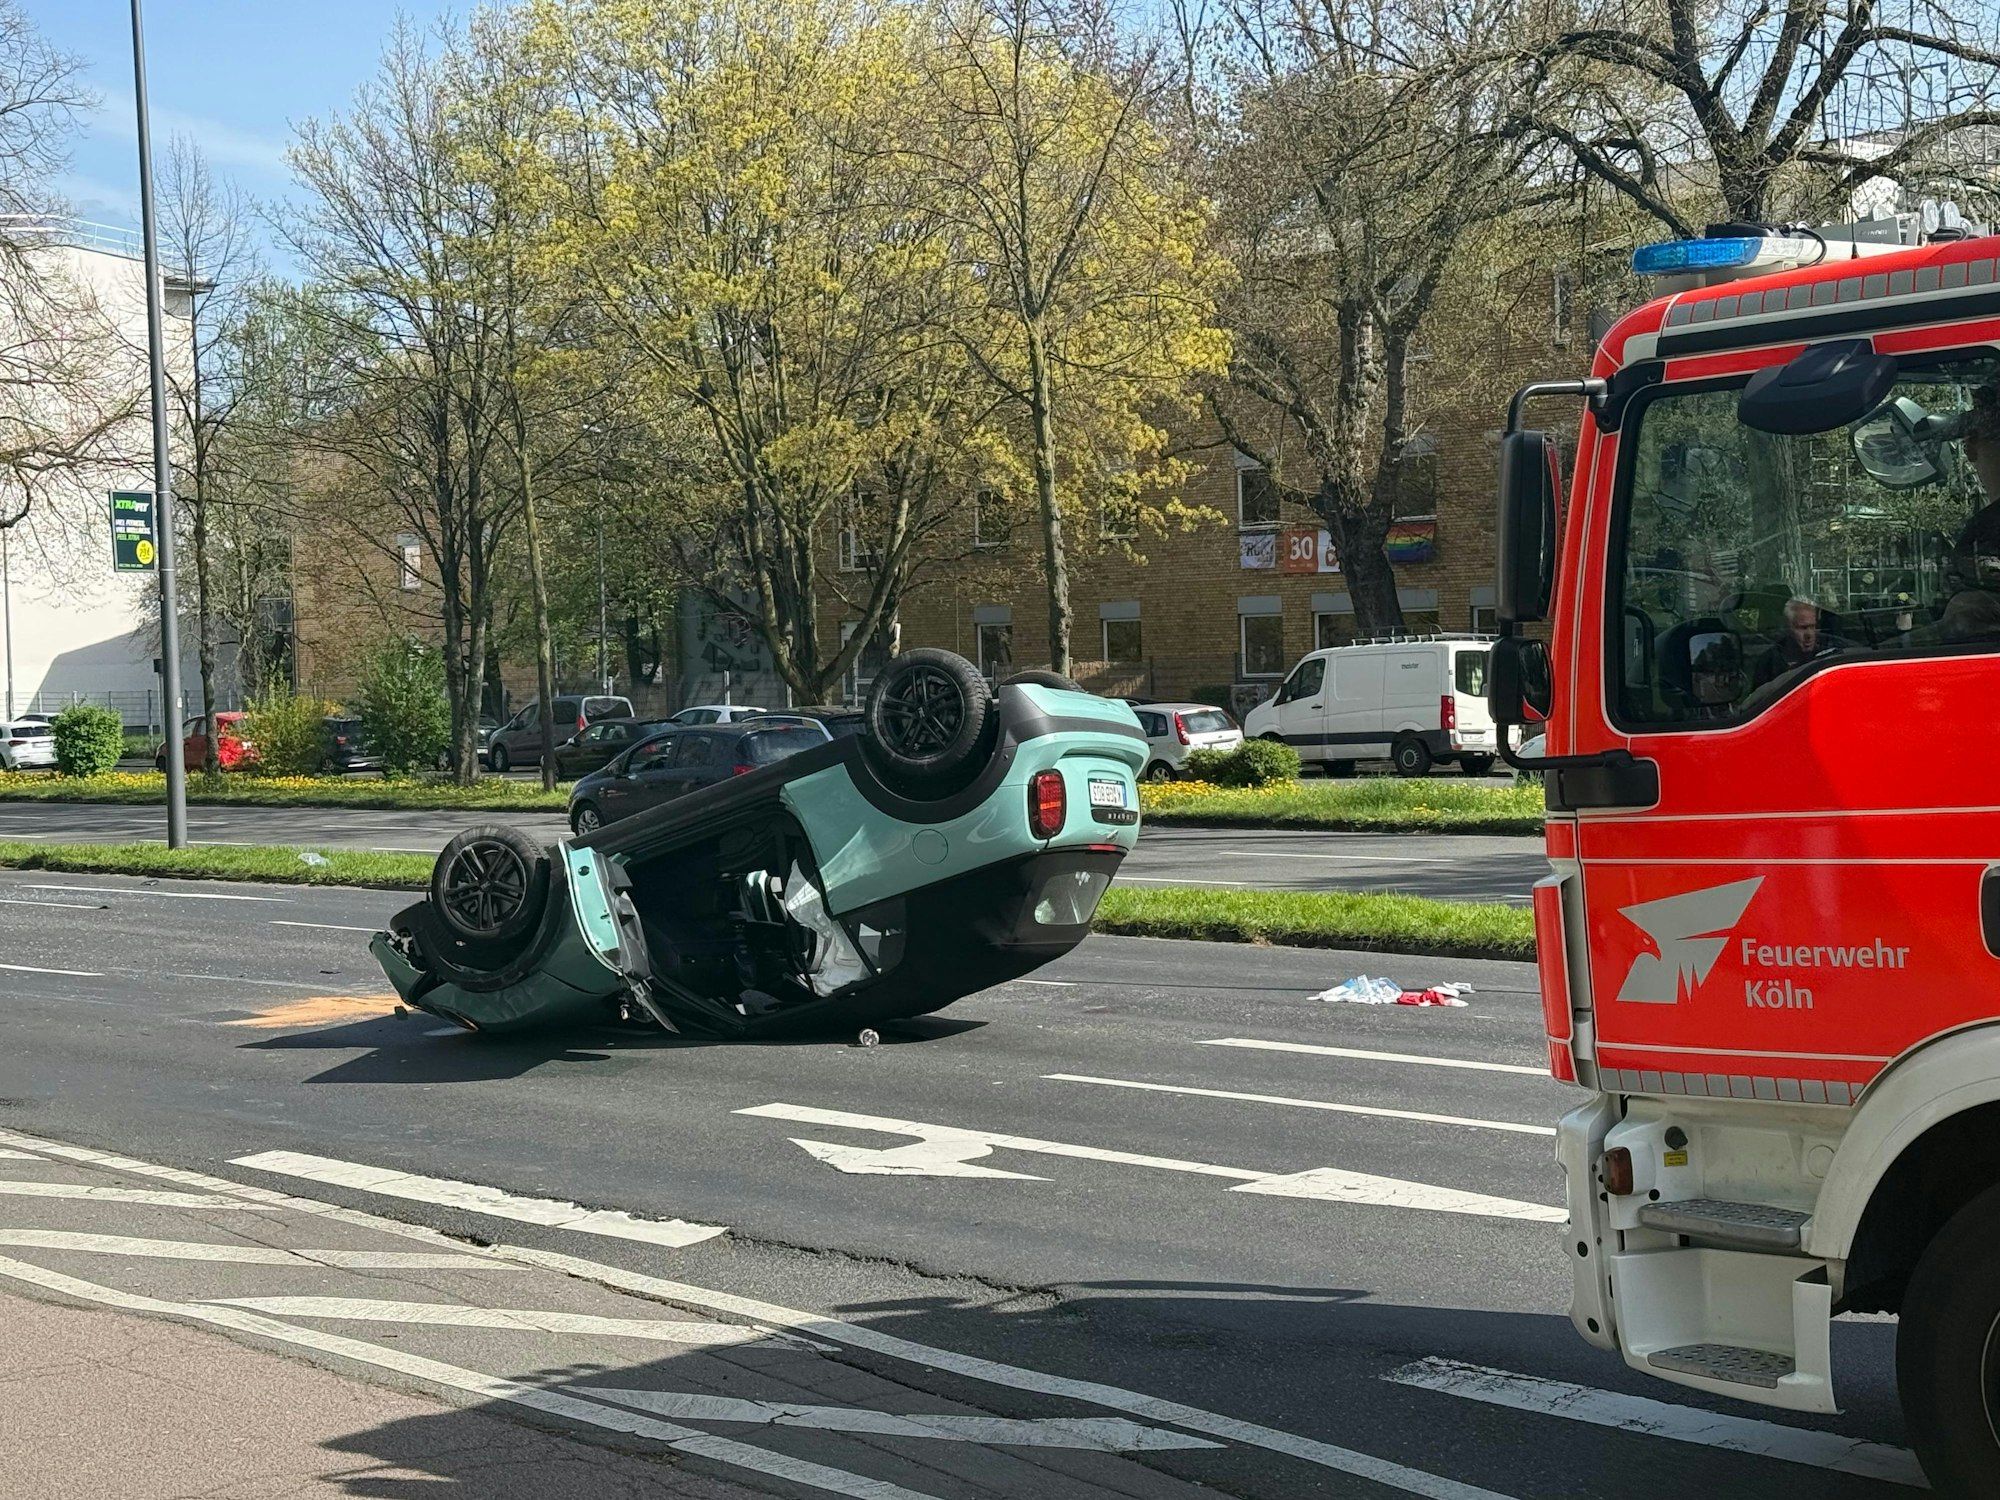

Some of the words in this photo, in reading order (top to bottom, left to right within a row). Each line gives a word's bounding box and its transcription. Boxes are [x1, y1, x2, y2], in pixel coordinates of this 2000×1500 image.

[115, 500, 150, 512] XTRAFIT
[1741, 938, 1910, 969] Feuerwehr
[1745, 979, 1814, 1009] Köln
